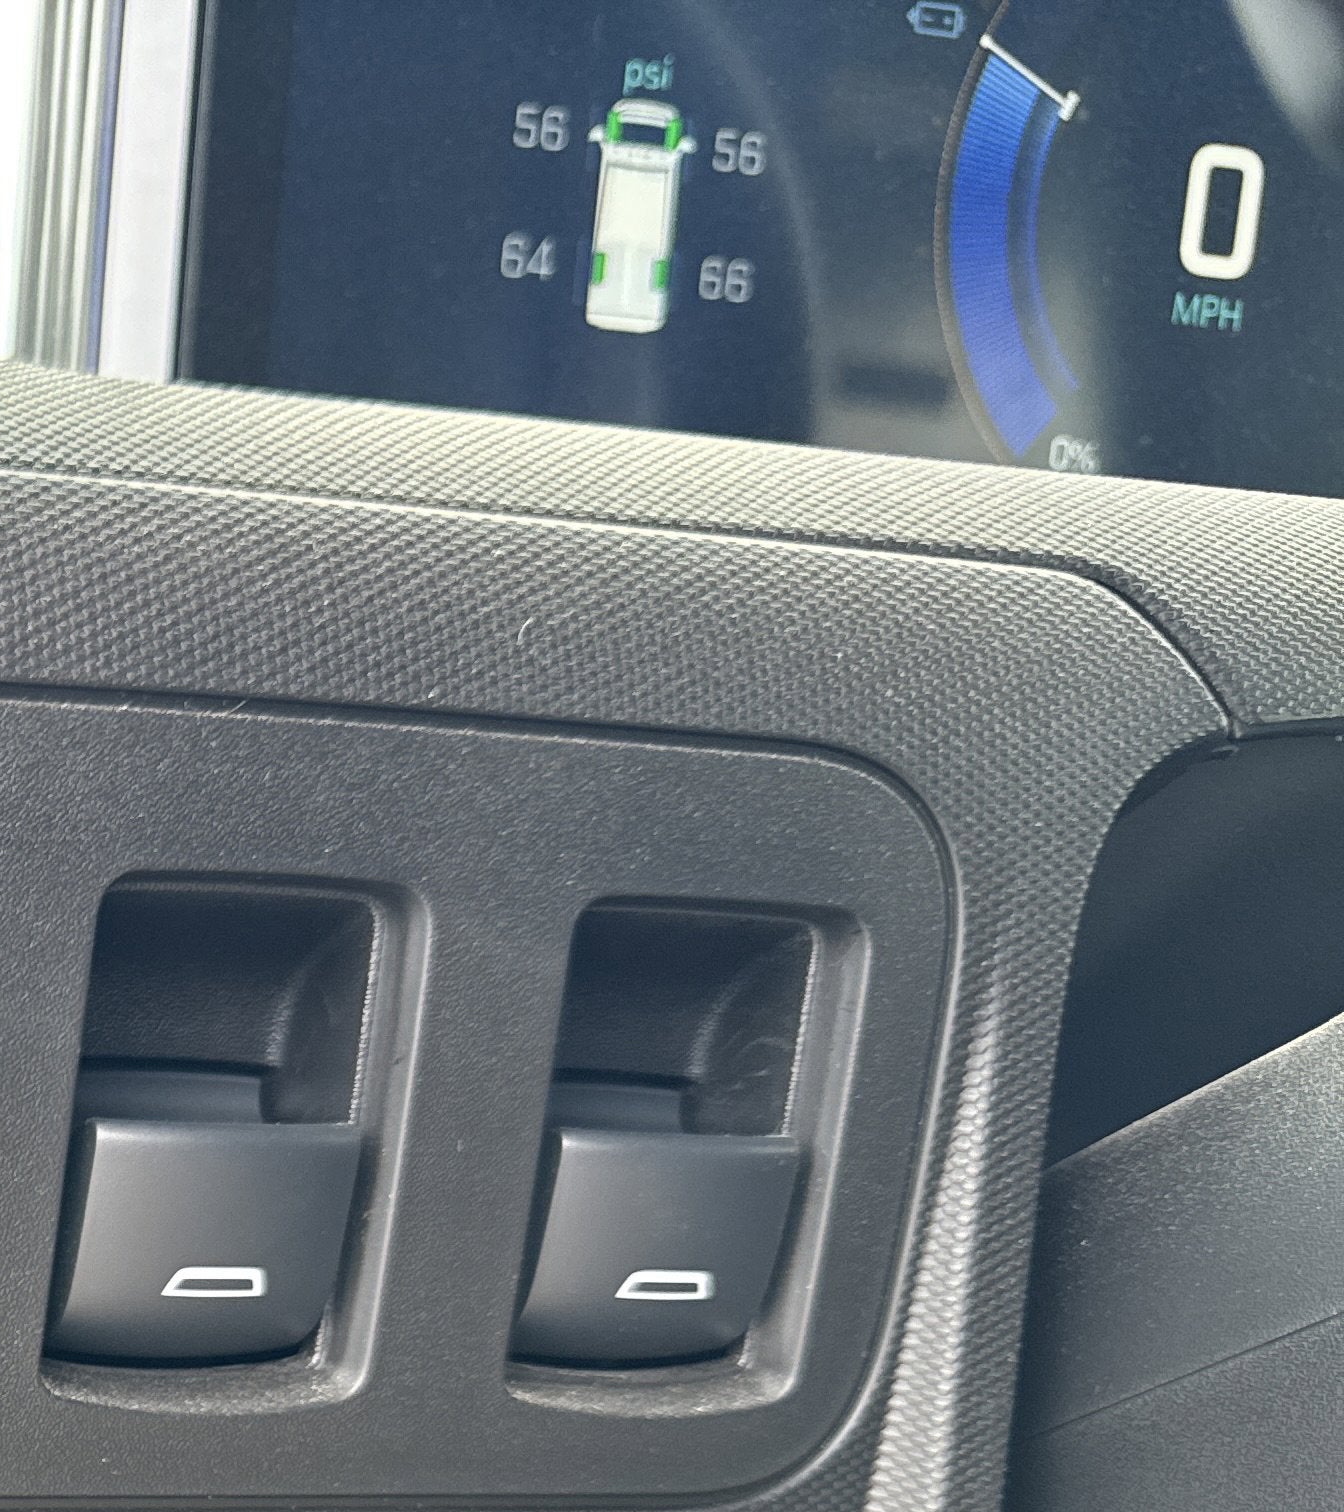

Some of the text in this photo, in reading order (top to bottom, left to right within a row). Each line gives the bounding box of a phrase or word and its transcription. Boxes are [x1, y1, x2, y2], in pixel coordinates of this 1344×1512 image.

[622, 53, 675, 96] psi
[512, 101, 570, 151] 56
[712, 127, 767, 176] 56
[1179, 142, 1265, 280] 0
[500, 232, 557, 281] 64
[698, 255, 756, 303] 66
[1171, 291, 1245, 332] MPH
[1048, 434, 1102, 473] 0%
